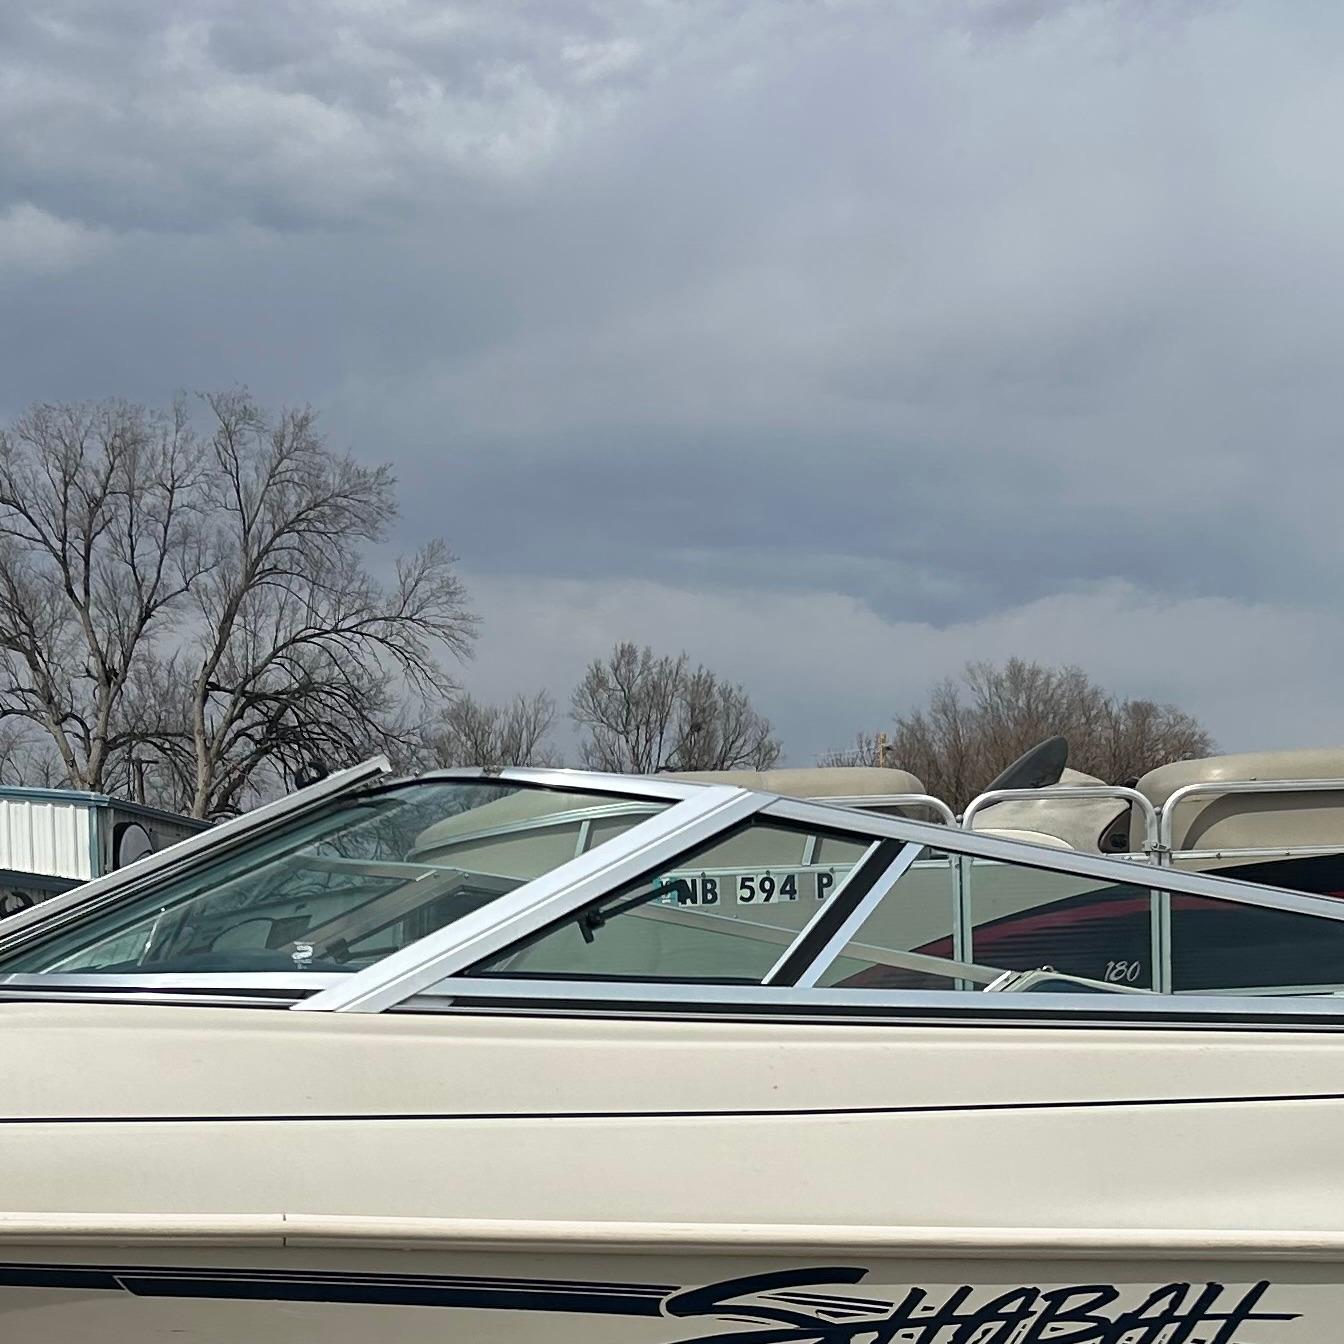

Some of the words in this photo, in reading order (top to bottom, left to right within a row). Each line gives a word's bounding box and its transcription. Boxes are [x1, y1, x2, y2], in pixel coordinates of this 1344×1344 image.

[677, 878, 718, 905] NB
[739, 874, 798, 903] 594
[817, 872, 834, 899] P
[1104, 960, 1141, 982] 180
